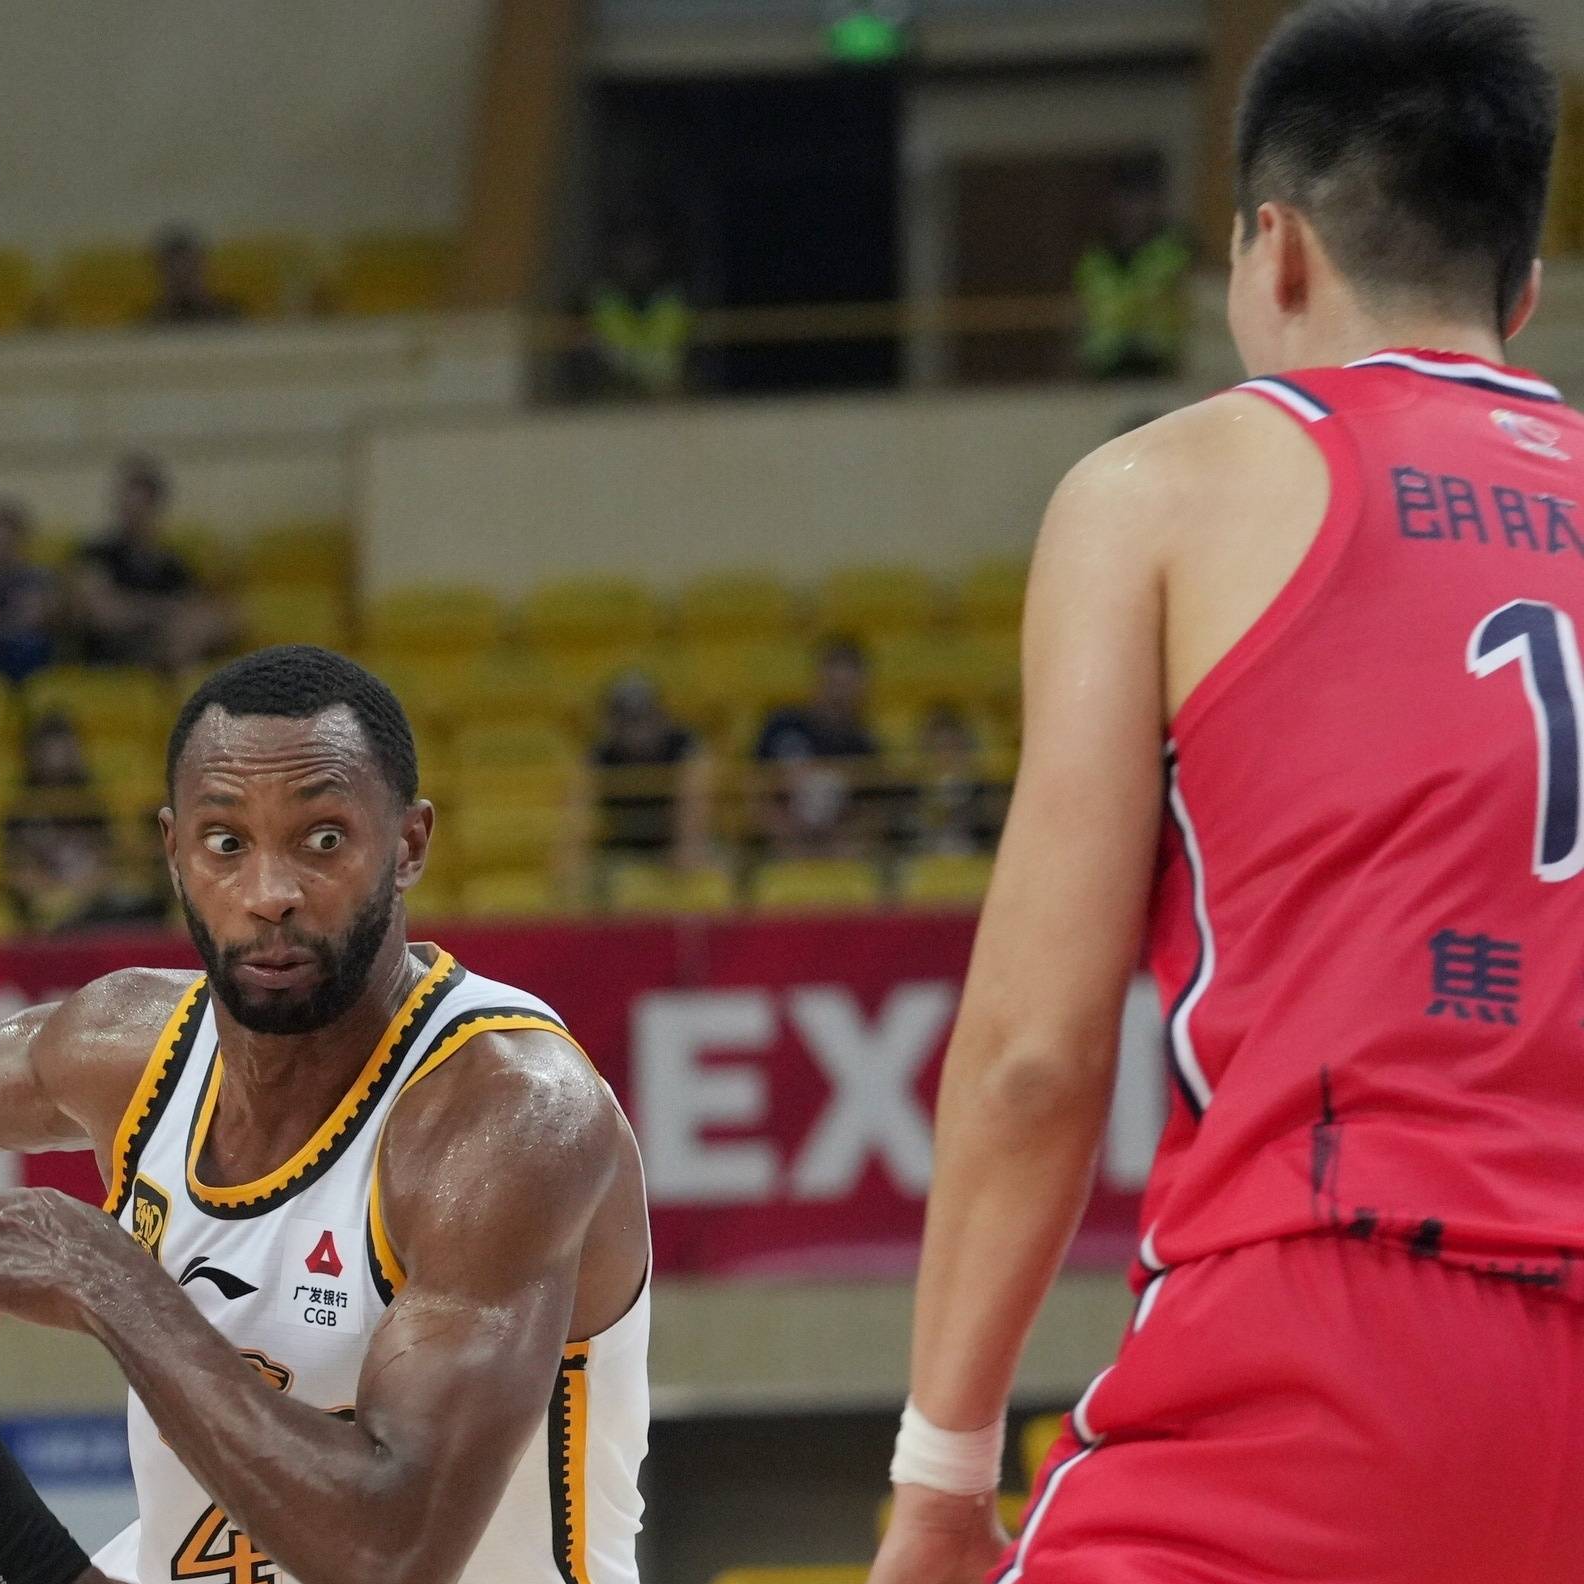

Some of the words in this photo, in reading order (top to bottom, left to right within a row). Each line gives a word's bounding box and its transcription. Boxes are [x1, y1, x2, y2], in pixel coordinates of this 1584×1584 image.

[293, 1285, 349, 1309] 广发银行
[303, 1307, 338, 1328] CGB
